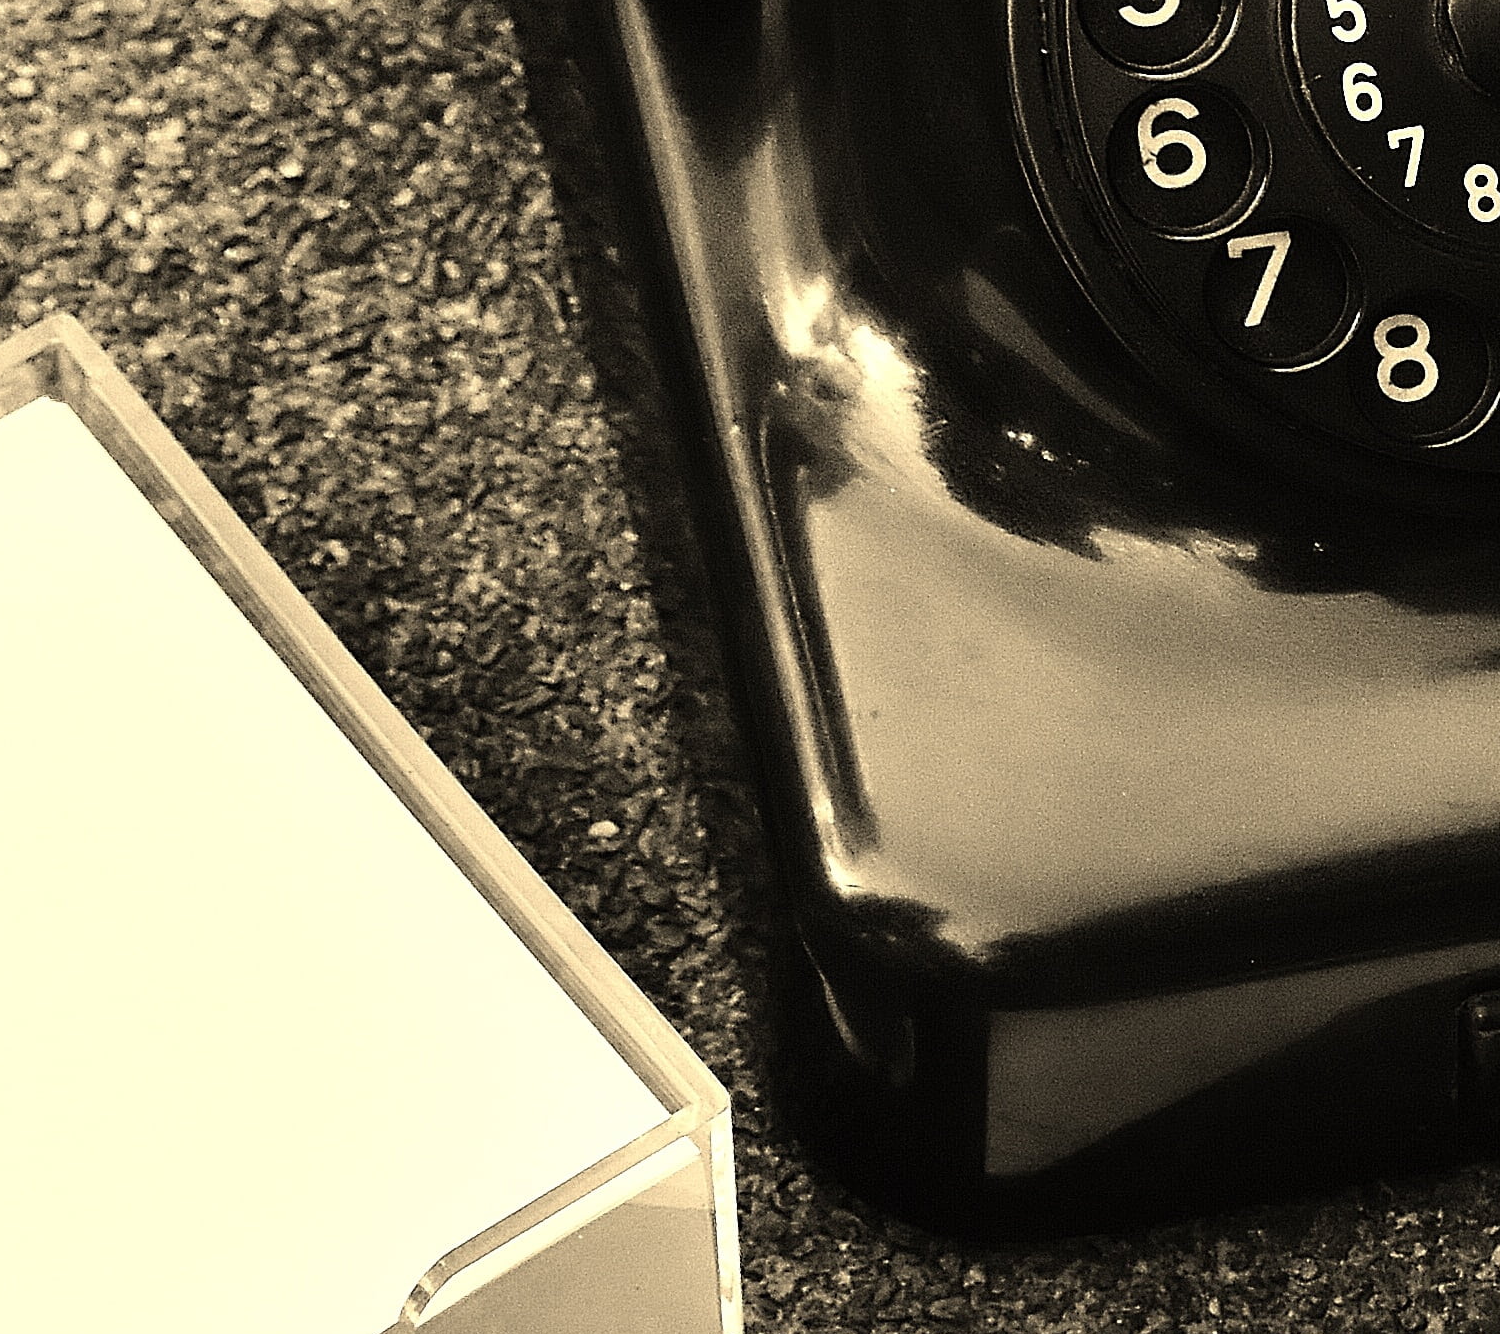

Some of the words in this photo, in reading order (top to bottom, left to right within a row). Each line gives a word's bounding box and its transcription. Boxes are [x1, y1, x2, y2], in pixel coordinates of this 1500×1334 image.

[1342, 62, 1383, 122] 6
[1137, 97, 1207, 189] 6
[1386, 124, 1425, 188] 7
[1226, 231, 1292, 328] 7
[1373, 313, 1440, 403] 8
